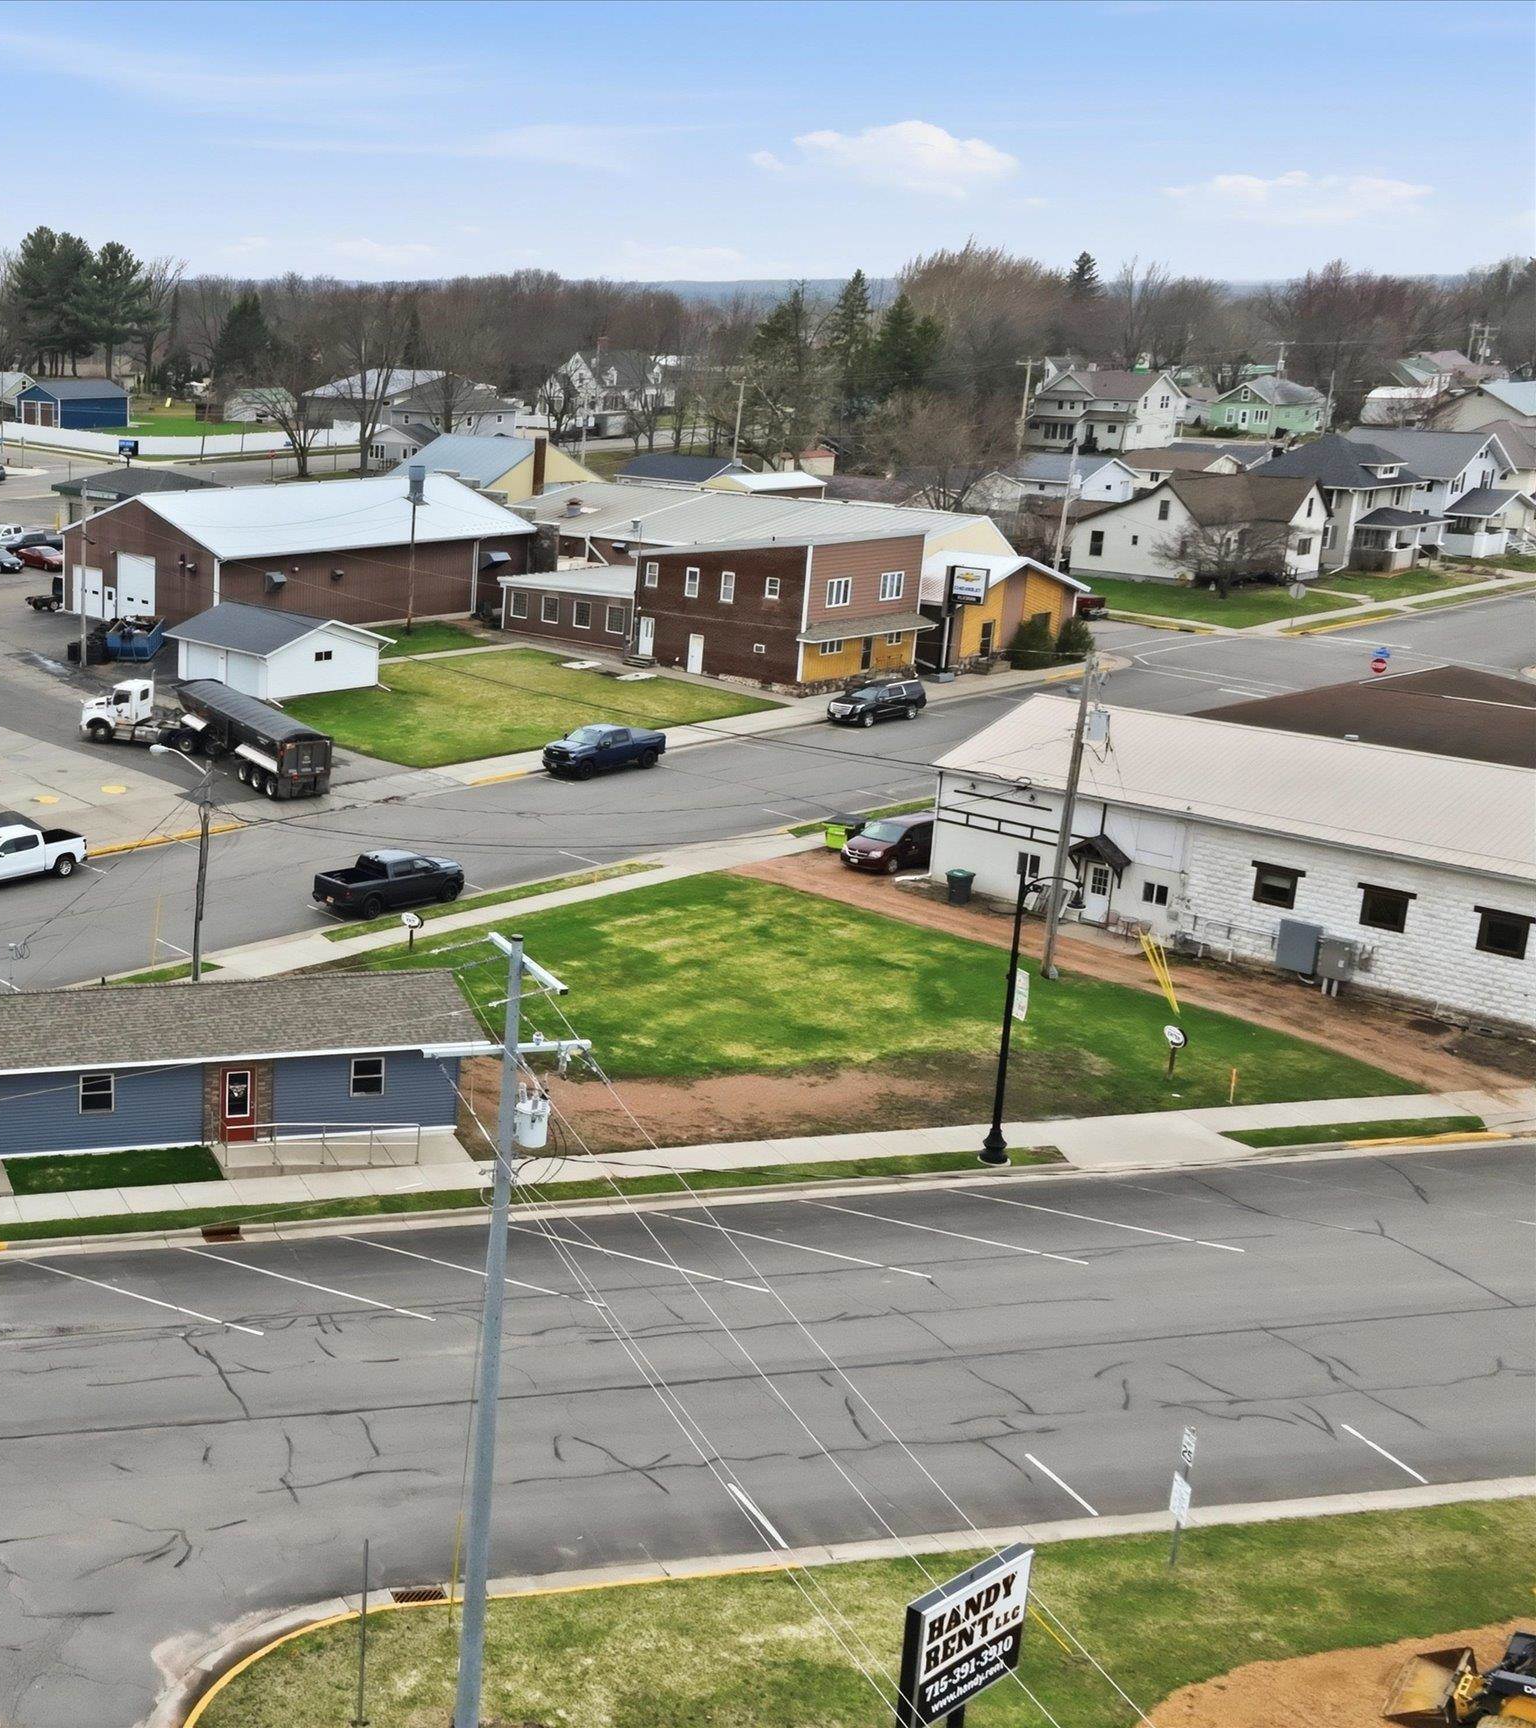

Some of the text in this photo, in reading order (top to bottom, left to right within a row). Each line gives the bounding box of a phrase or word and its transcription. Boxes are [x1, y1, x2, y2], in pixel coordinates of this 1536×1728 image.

[924, 1605, 1020, 1675] RENT LLC
[927, 1571, 1018, 1646] HANDY
[925, 1635, 1013, 1702] 715-391-3910
